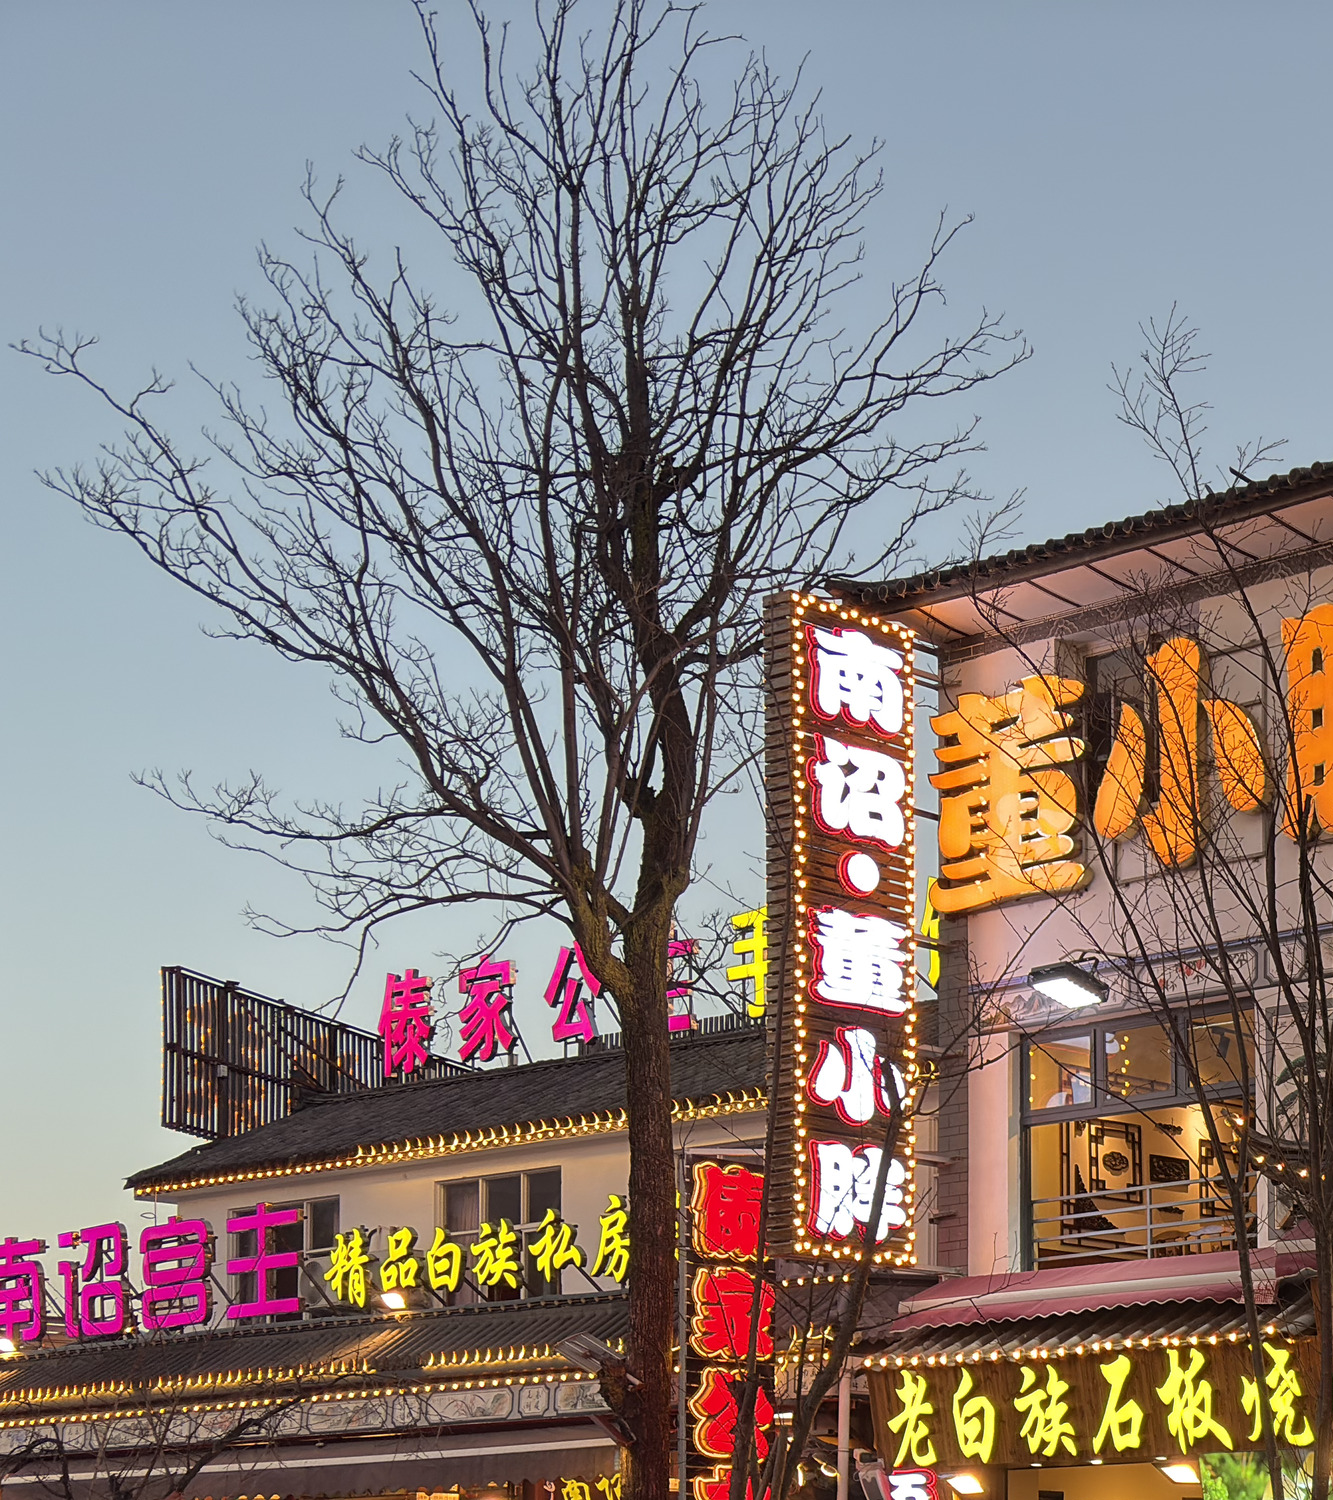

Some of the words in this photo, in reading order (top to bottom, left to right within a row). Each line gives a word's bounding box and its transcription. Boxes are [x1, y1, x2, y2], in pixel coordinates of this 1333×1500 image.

[378, 938, 697, 1078] 傣家公
[324, 1193, 679, 1308] 精品白族私房
[887, 1340, 1317, 1467] 老白族石板烧
